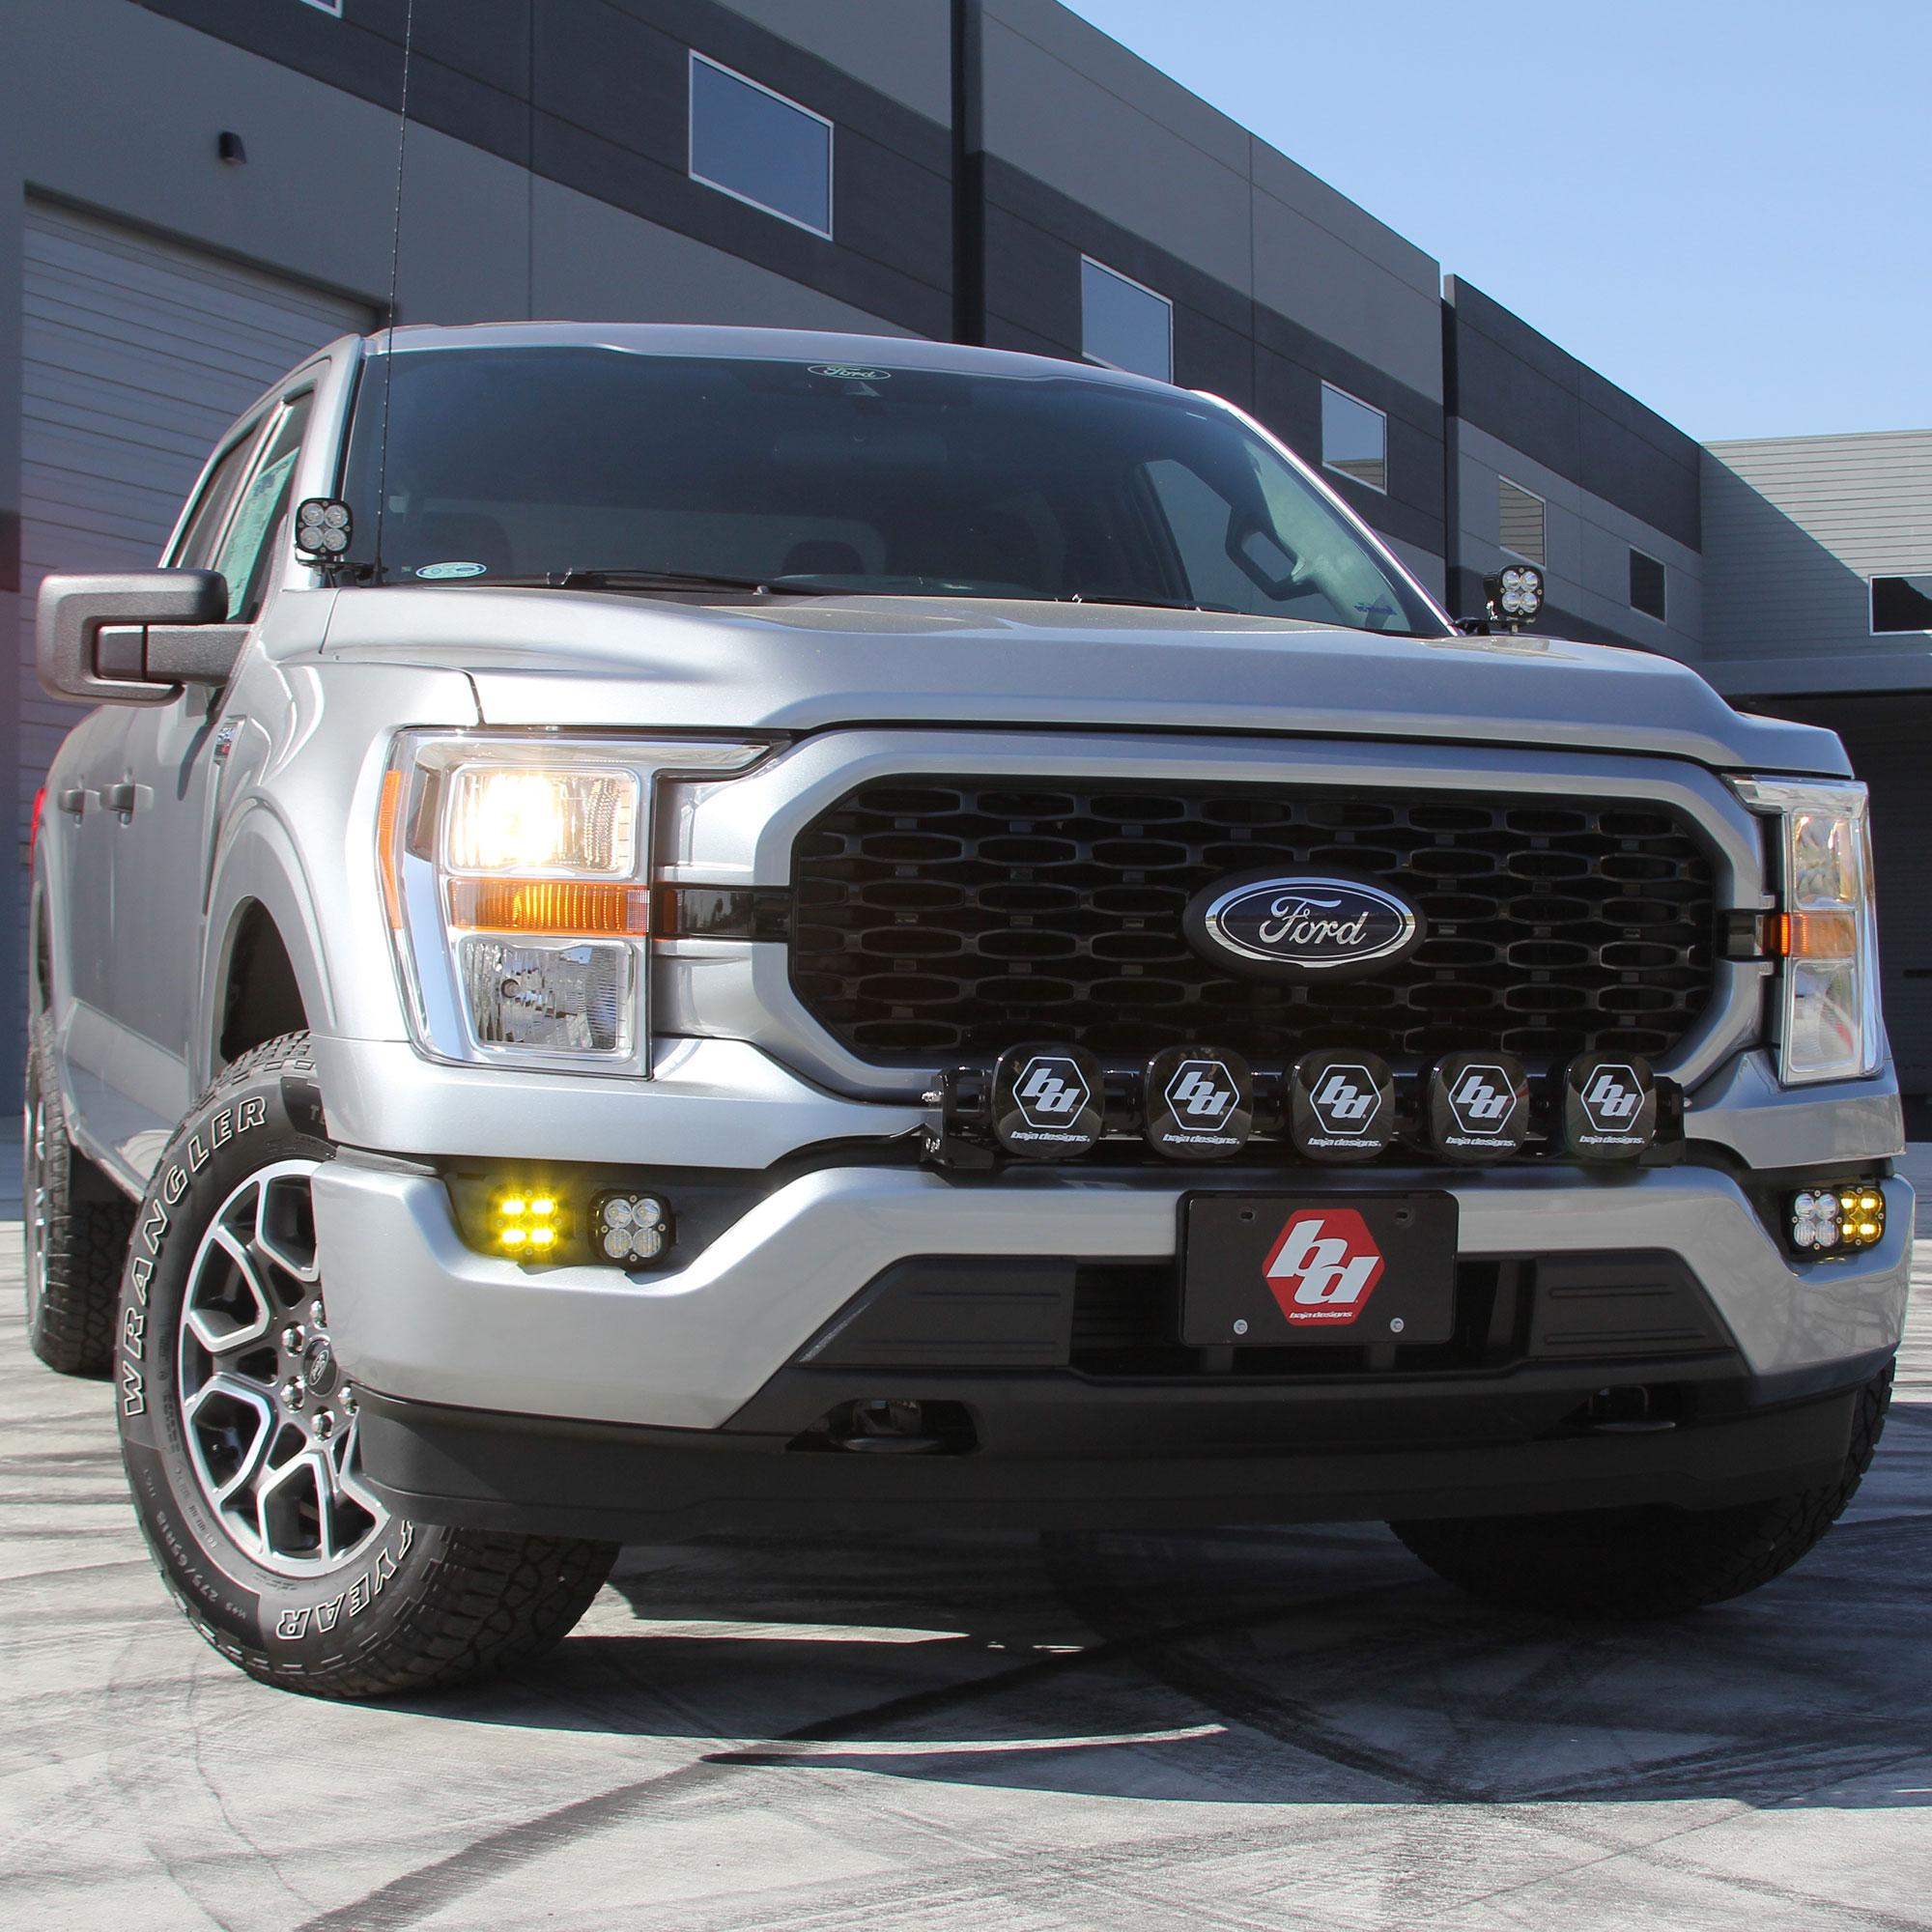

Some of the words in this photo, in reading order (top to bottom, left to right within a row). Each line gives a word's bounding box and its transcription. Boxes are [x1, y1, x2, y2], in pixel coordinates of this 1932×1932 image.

[823, 365, 876, 378] Ford
[1259, 895, 1370, 945] Ford
[1010, 1130, 1039, 1141] baja
[1038, 1132, 1089, 1142] designs
[1162, 1133, 1191, 1144] baja
[1189, 1135, 1237, 1145] designs
[1445, 1136, 1472, 1146] baja
[1470, 1137, 1515, 1147] designs
[1578, 1135, 1604, 1145] baja
[1602, 1135, 1643, 1145] designs
[1307, 1137, 1335, 1147] baja
[1333, 1138, 1379, 1148] designs
[123, 1095, 267, 1417] WRANGLER
[1289, 1312, 1314, 1321] baja
